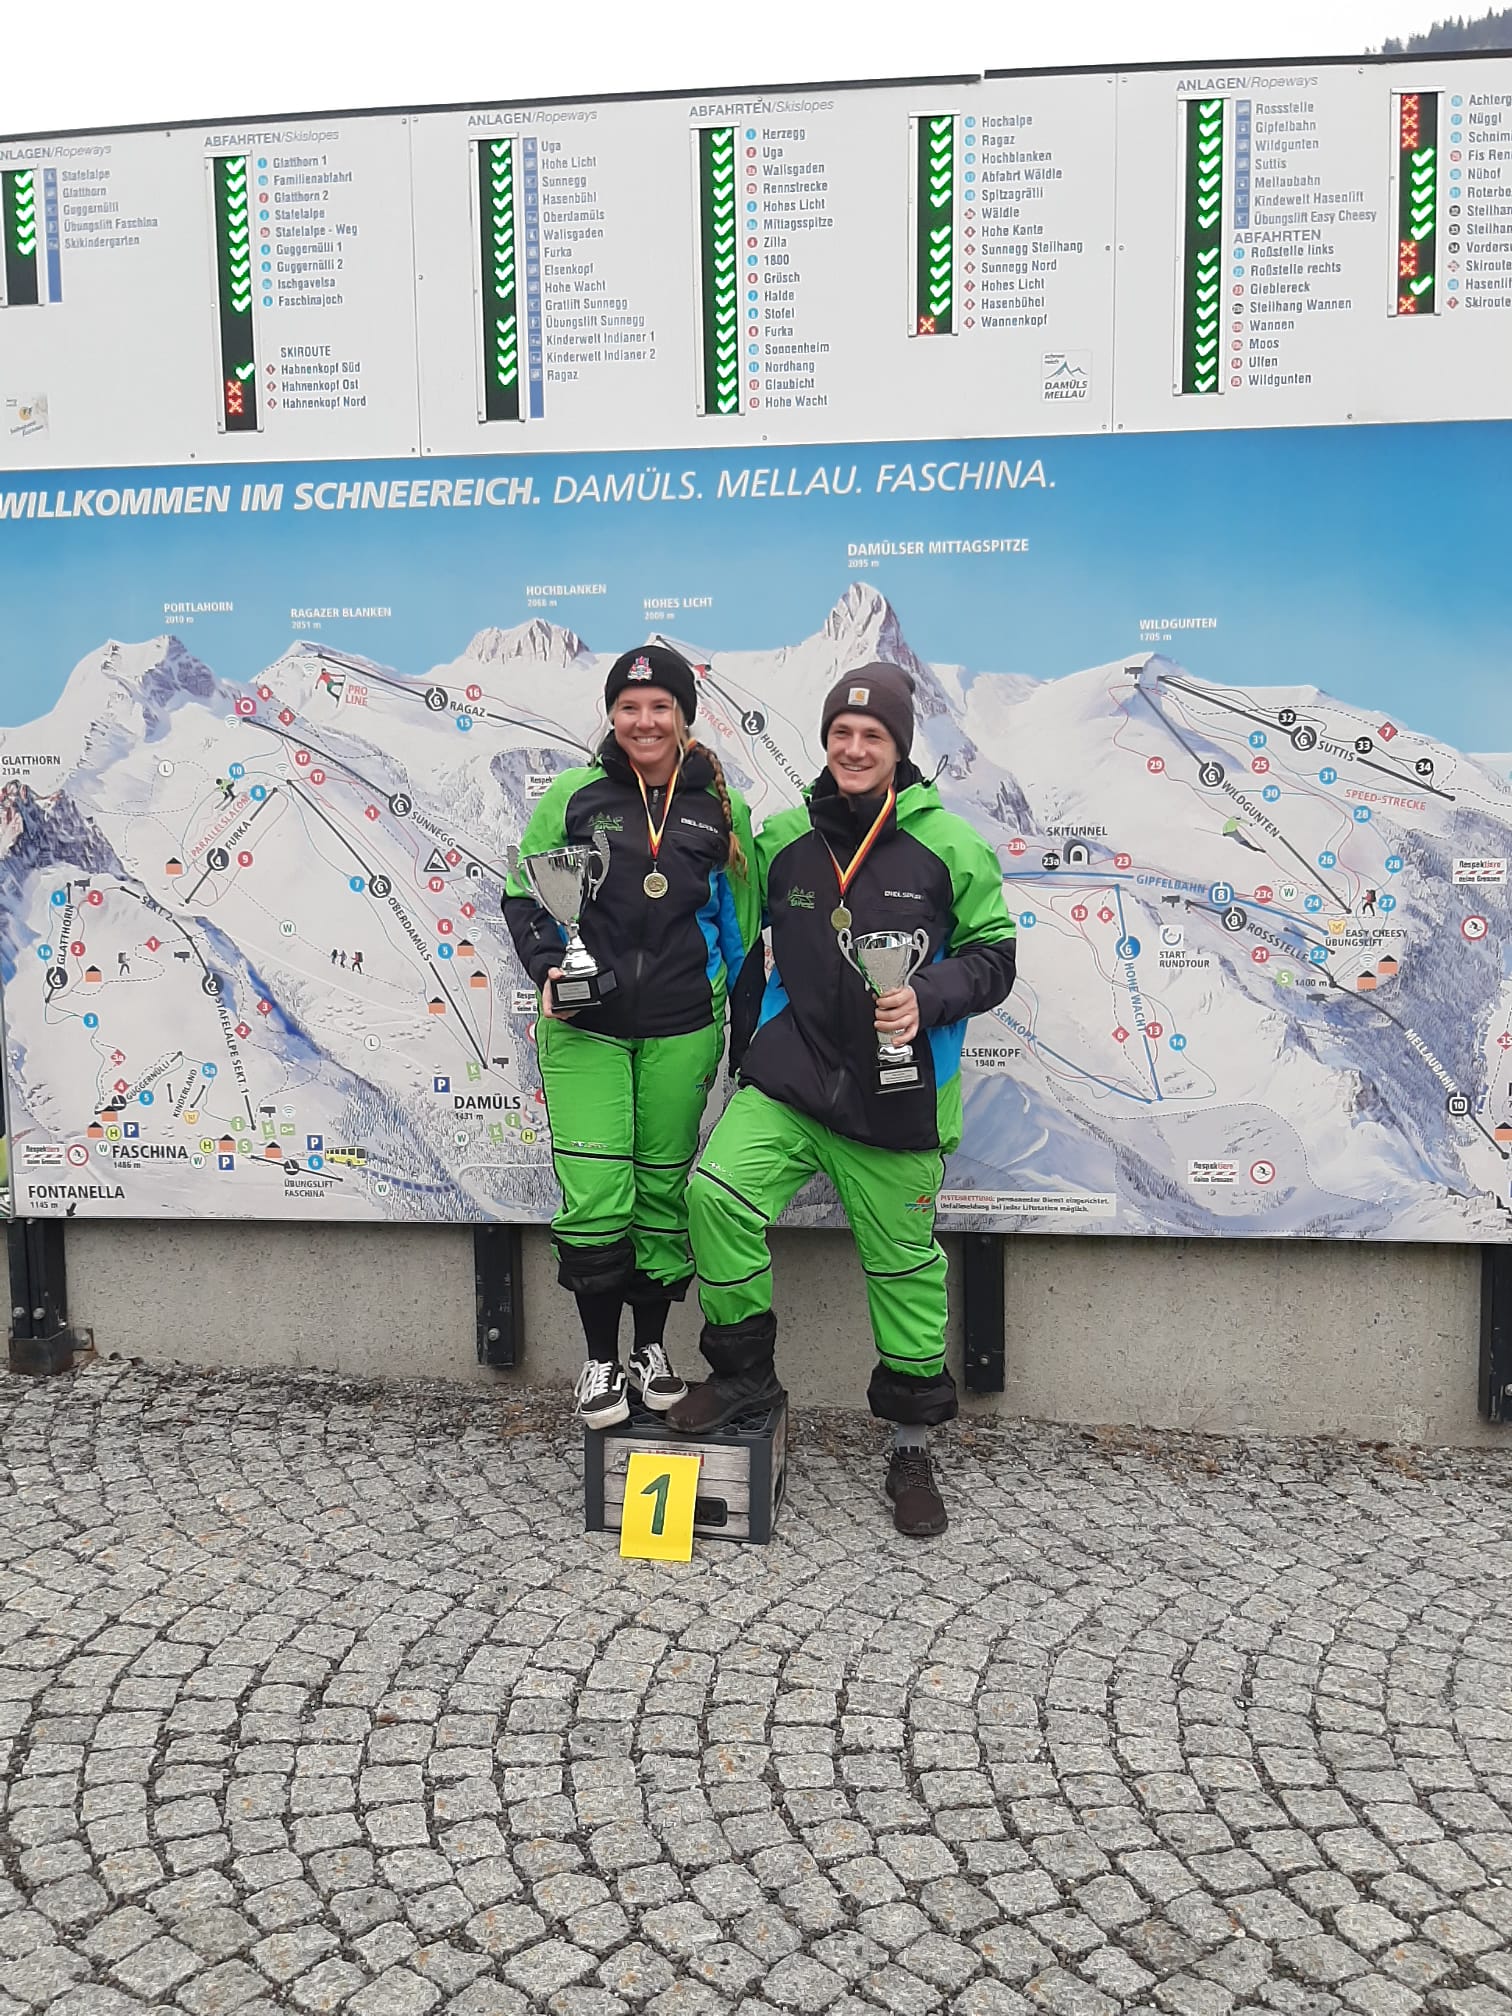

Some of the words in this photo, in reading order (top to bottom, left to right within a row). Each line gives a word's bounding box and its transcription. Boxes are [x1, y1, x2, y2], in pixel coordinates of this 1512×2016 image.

[1177, 75, 1318, 92] ANLAGEN/Ropeways
[689, 100, 834, 118] ABFAHRTEN/Skislopes
[468, 110, 598, 126] ANLAGEN/Ropeways
[204, 130, 339, 147] ABFAHRTEN/Skislopes
[763, 129, 805, 140] Herzegg
[542, 141, 560, 153] Uga
[982, 135, 1014, 147] Ragaz
[763, 147, 783, 160] Uga
[982, 151, 1051, 164] Hochblanken
[322, 155, 326, 165] 1
[542, 158, 568, 169] Hohe
[572, 156, 596, 168] Licht
[542, 176, 586, 188] Sunnegg
[764, 181, 827, 194] Rennstrecke
[543, 192, 596, 204] Hasenbühl
[764, 200, 796, 212] Hohes
[800, 198, 824, 210] Licht
[982, 207, 1019, 218] Wäldle
[982, 226, 1008, 237] Hohe
[1013, 224, 1043, 235] Kante
[764, 236, 786, 248] Zilla
[1234, 229, 1321, 245] ABFAHRTEN
[544, 247, 572, 258] Furka
[1308, 244, 1334, 255] links
[764, 254, 789, 265] 1800
[982, 262, 1028, 274] Sunnegg
[1032, 259, 1056, 271] Nord
[1308, 262, 1341, 273] rechts
[764, 272, 800, 283] Grüsch
[545, 282, 570, 293] Hohe
[574, 280, 605, 291] Wacht
[982, 280, 1014, 291] Hohes
[1019, 278, 1044, 290] Licht
[279, 294, 342, 307] Faschinajoch
[765, 290, 794, 301] Halde
[982, 296, 1044, 309] Hasenbühel
[1307, 299, 1351, 310] Wannen
[765, 308, 794, 319] Stofel
[981, 314, 1047, 327] Wannenkopf
[765, 326, 793, 336] Furka
[1250, 339, 1279, 349] Moos
[281, 346, 330, 358] SKIROUTE
[342, 362, 360, 372] Süd
[766, 360, 814, 373] Nordhang
[1249, 356, 1277, 367] Ulfen
[548, 370, 578, 382] Ragaz
[1248, 374, 1311, 387] Wildgunten
[1045, 380, 1088, 390] DAMÜLS
[1045, 390, 1086, 399] MELLAU
[344, 396, 366, 406] Nord
[766, 396, 791, 408] Hohe
[795, 395, 827, 406] Wacht
[0, 486, 230, 519] WILLKOMMEN
[241, 484, 283, 512] IM
[294, 477, 540, 510] SCHNEEREICH.
[553, 467, 703, 504] DAMÜLS.
[716, 465, 863, 497] MELLAU.
[876, 459, 1055, 493] FASCHINA.
[847, 539, 924, 556] DAMÜLSER
[928, 538, 1029, 554] MITTAGSPITZE
[526, 584, 607, 596] HOCHBLANKEN
[164, 602, 233, 613] PORTLAHORN
[643, 598, 680, 609] HOHES
[683, 597, 713, 608] LICHT
[291, 608, 339, 618] RAGAZER
[342, 606, 392, 618] BLANKEN
[1139, 618, 1217, 630] WILDGUNTEN
[348, 685, 368, 696] PRO
[468, 688, 480, 698] 16
[346, 696, 368, 706] LINE
[450, 701, 486, 718] RAGAZ
[1280, 712, 1294, 723] 32
[1252, 735, 1264, 745] 31
[1357, 741, 1371, 751] 33
[760, 733, 787, 766] HOHES
[1316, 740, 1356, 762] SUTTIS
[1, 756, 61, 766] GLATTHORN
[1150, 760, 1162, 770] 29
[1254, 761, 1267, 771] 25
[1418, 762, 1431, 773] 34
[1265, 789, 1277, 799] 30
[1345, 788, 1426, 811] SPEED-STRECKE
[1221, 780, 1281, 838] WILDGUNTEN
[225, 820, 252, 851] FURKA
[411, 811, 455, 848] SUNNEGG
[1047, 825, 1108, 837] SKITUNNEL
[1009, 841, 1026, 851] 23b
[1043, 857, 1060, 866] 23a
[1117, 856, 1129, 866] 23
[1136, 874, 1206, 893] GIPFELBAHN
[164, 911, 173, 922] 2
[57, 904, 73, 965] GLATTHORN
[388, 896, 432, 963] OBERDAMÜLS
[1345, 929, 1370, 938] EASY
[1372, 928, 1408, 938] CHEESY
[1247, 922, 1310, 962] ROSSSTELLE
[1325, 937, 1383, 947] ÜBUNGSLIFT
[1159, 950, 1186, 959] START
[1159, 959, 1210, 968] RUNDTOUR
[1125, 962, 1137, 992] HOHE
[1130, 993, 1147, 1033] WACHT
[214, 997, 238, 1060] STAFELALPE
[975, 1059, 995, 1067] 1940
[1404, 1028, 1458, 1093] MELLAUBAHN
[126, 1061, 170, 1101] GUGGERNÜLLI
[172, 1068, 197, 1119] KINDERLAND
[454, 1094, 521, 1110] DAMÜLS
[112, 1144, 188, 1160] FASCHINA
[284, 1178, 333, 1189] ÜBUNGSLIFT
[28, 1185, 126, 1199] FONTANELLA
[284, 1189, 325, 1199] FASCHINA
[640, 1474, 671, 1536] 1
